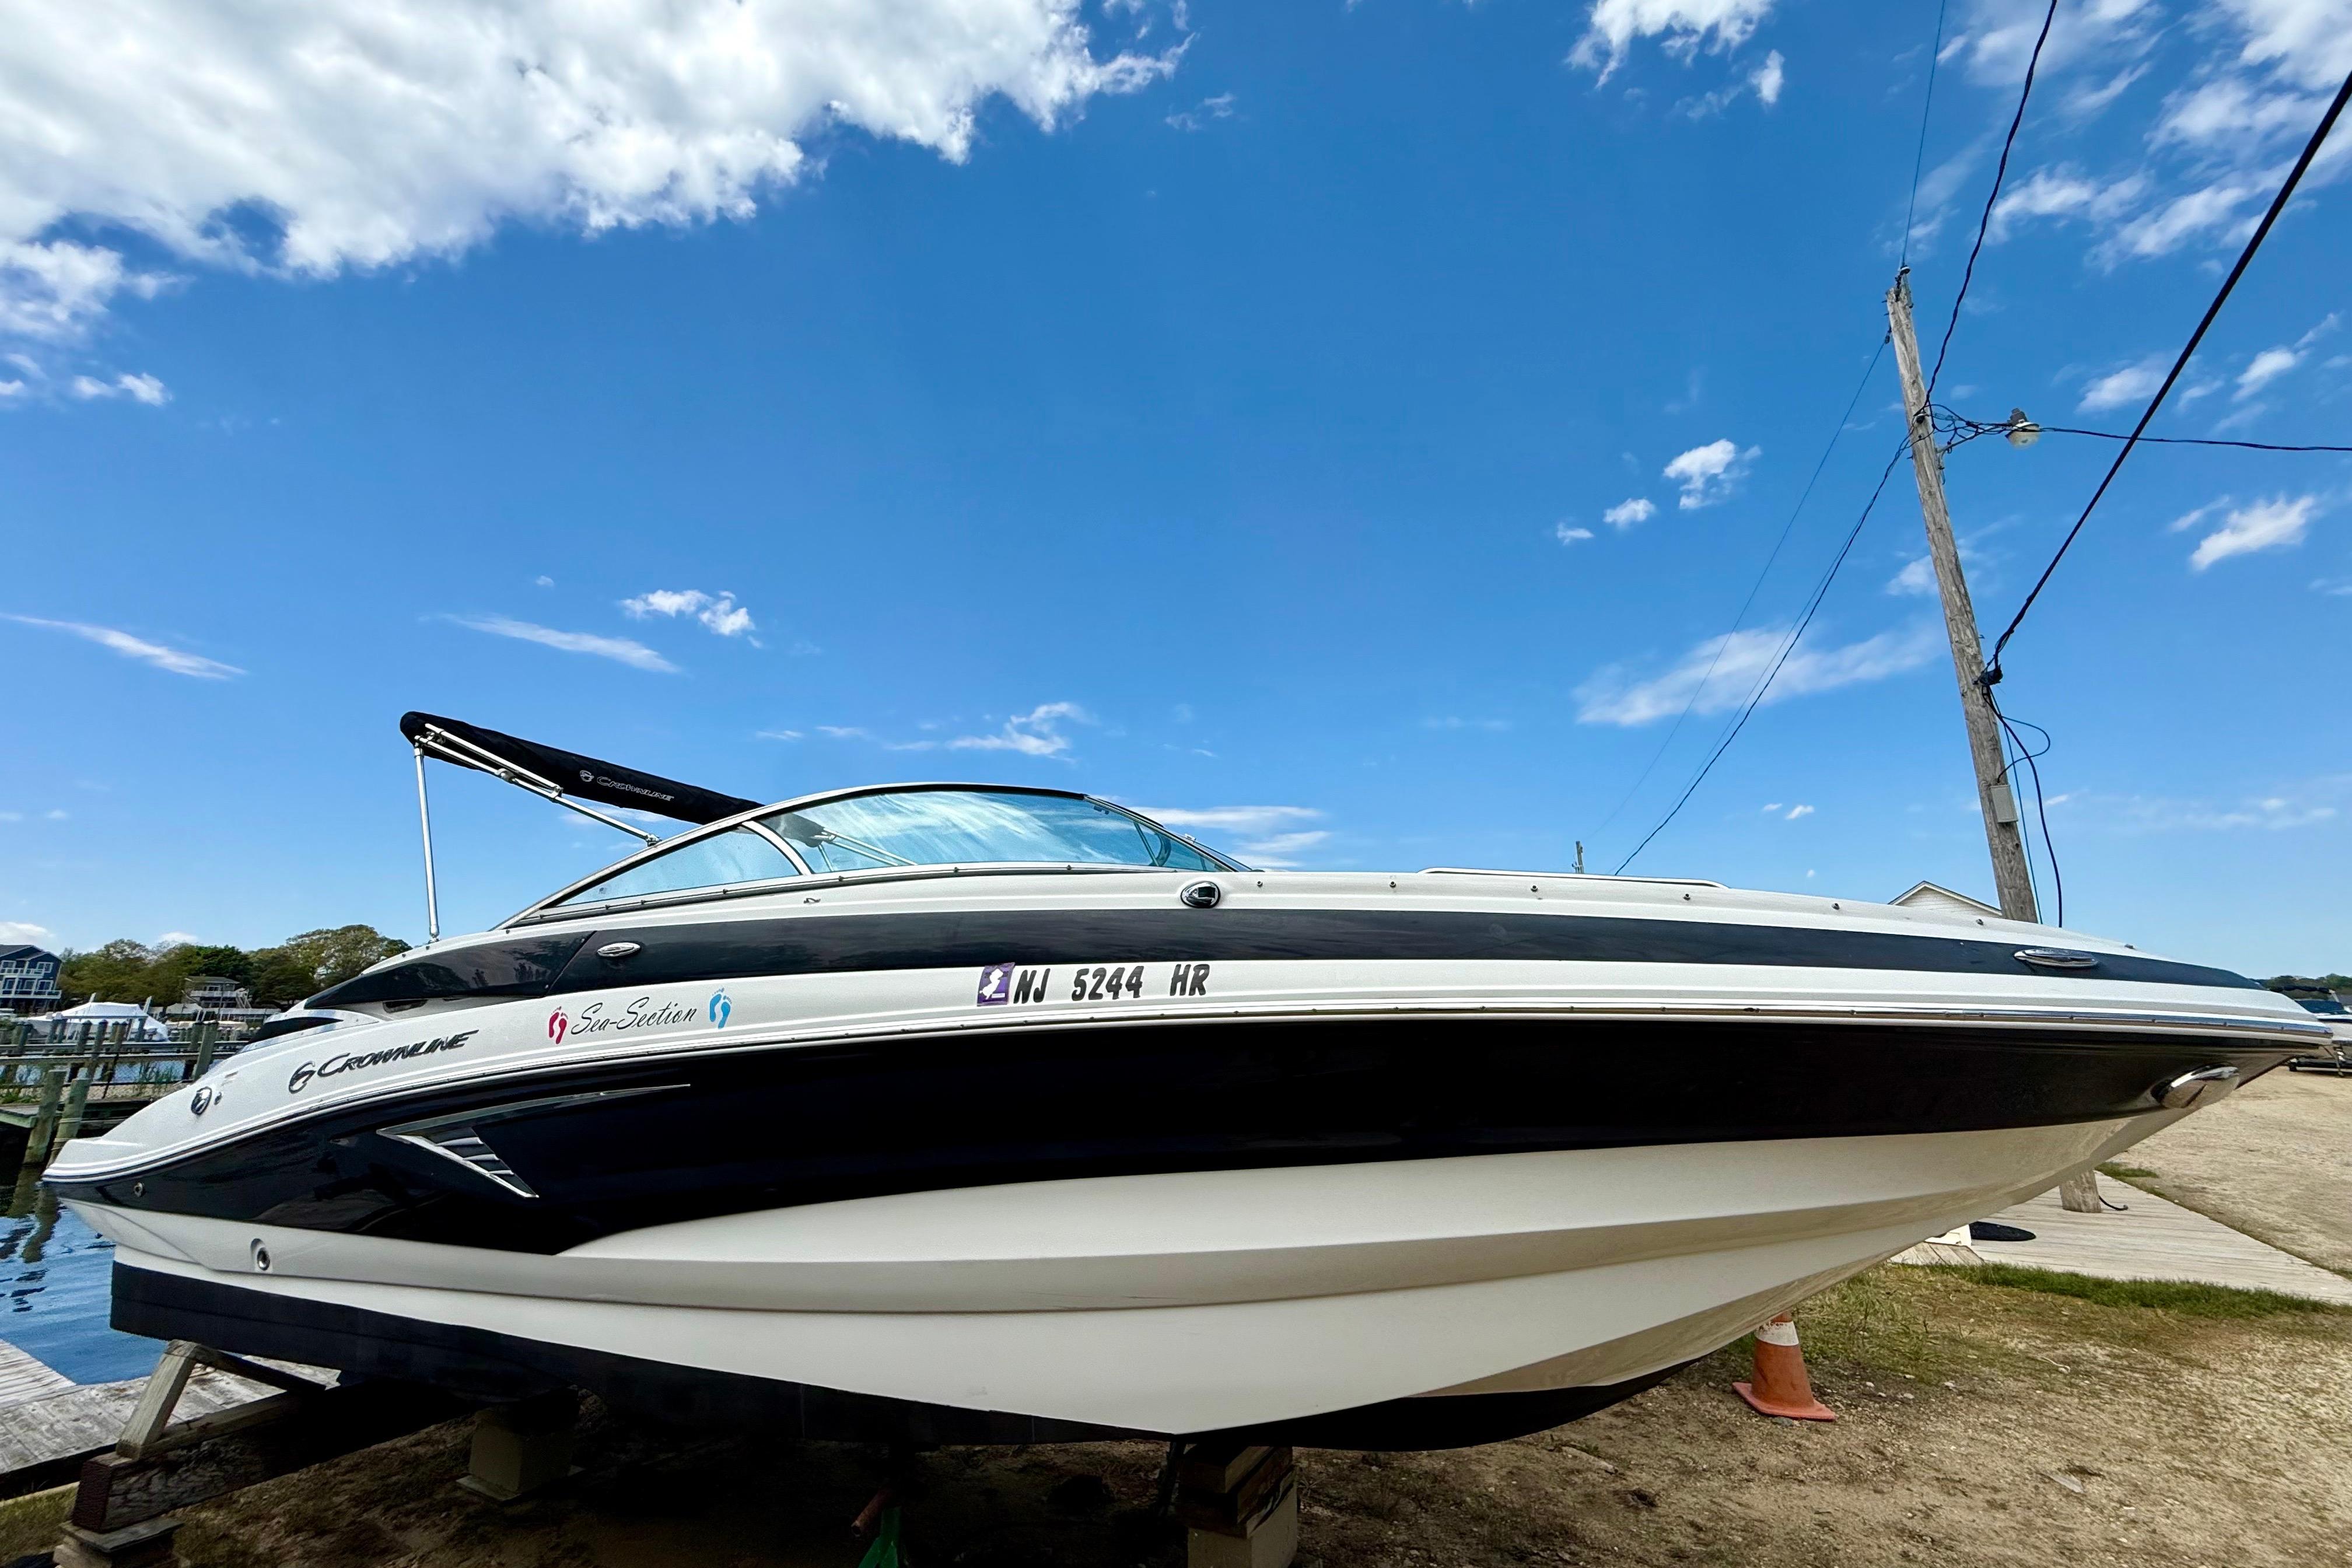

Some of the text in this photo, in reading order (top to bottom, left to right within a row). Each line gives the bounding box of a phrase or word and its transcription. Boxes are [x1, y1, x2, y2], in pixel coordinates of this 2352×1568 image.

[1013, 964, 1210, 1004] NJ 5244 HR
[571, 996, 697, 1035] Sea-Section
[317, 1030, 479, 1077] CROWNLINE
